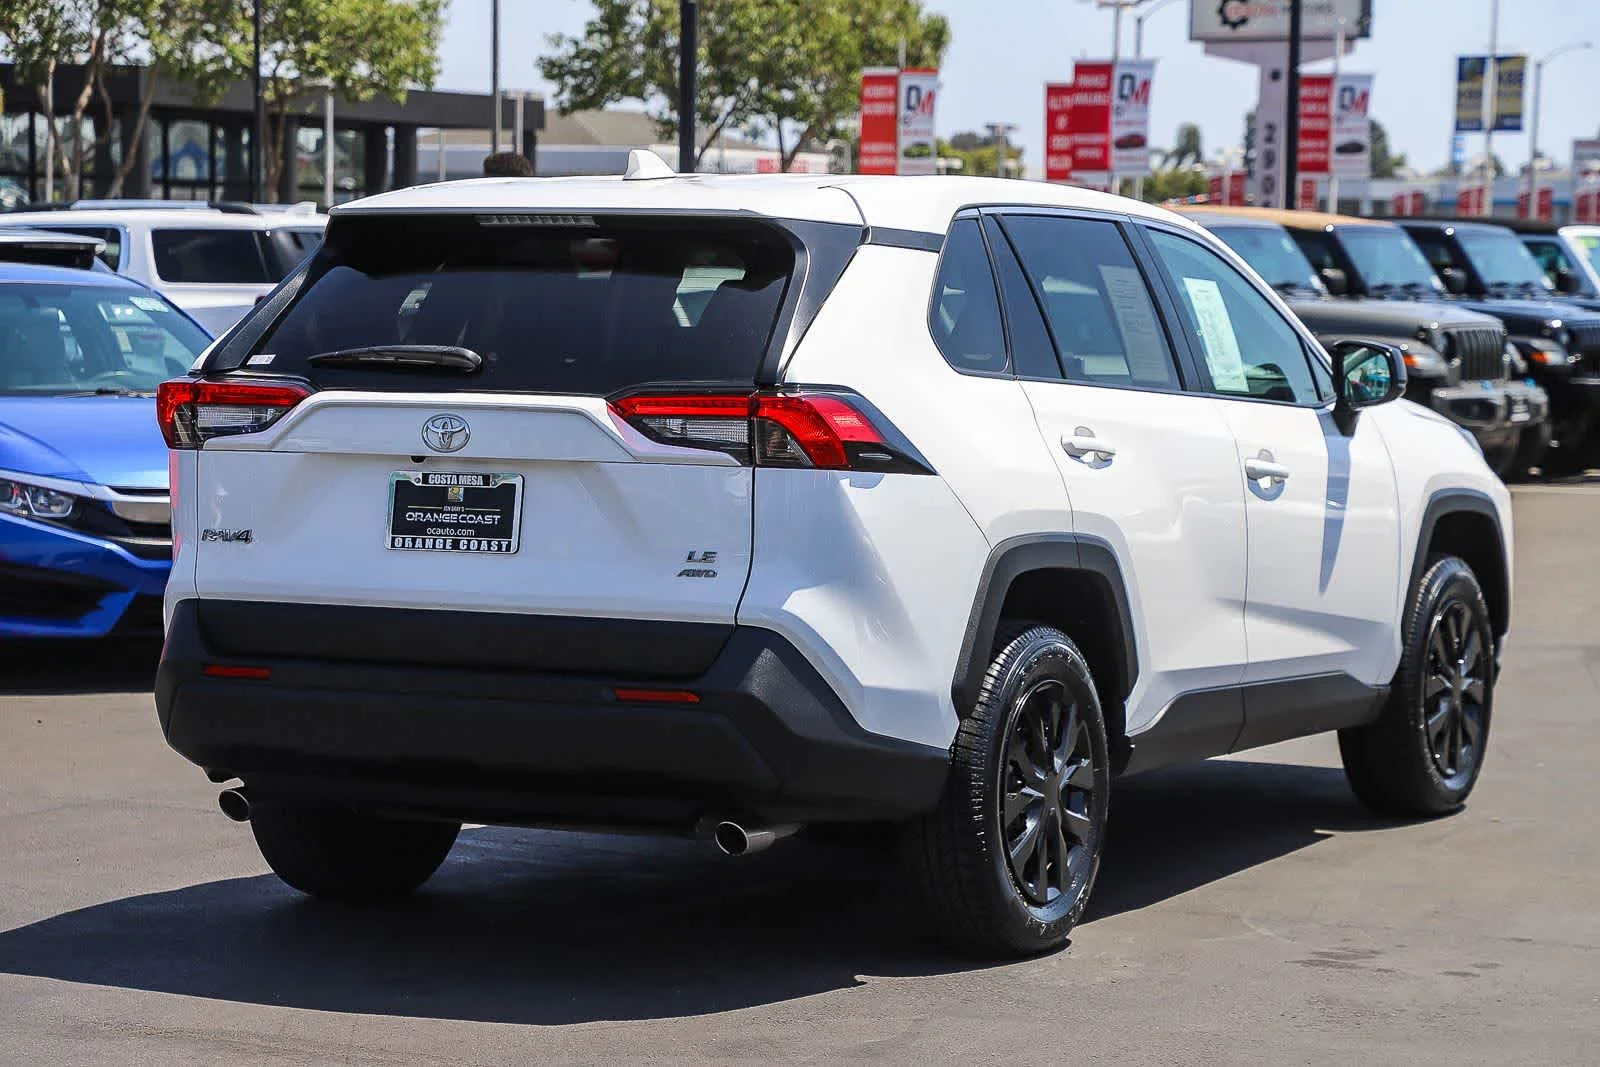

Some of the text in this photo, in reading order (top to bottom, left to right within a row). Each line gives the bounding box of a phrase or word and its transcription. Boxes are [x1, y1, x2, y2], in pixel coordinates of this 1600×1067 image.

[428, 473, 484, 486] COSTA MESA
[201, 528, 253, 544] RAV4
[426, 527, 475, 537] ocauto.com
[394, 537, 509, 552] ORANGE COAST
[686, 550, 718, 563] LE
[676, 568, 718, 578] AWD
